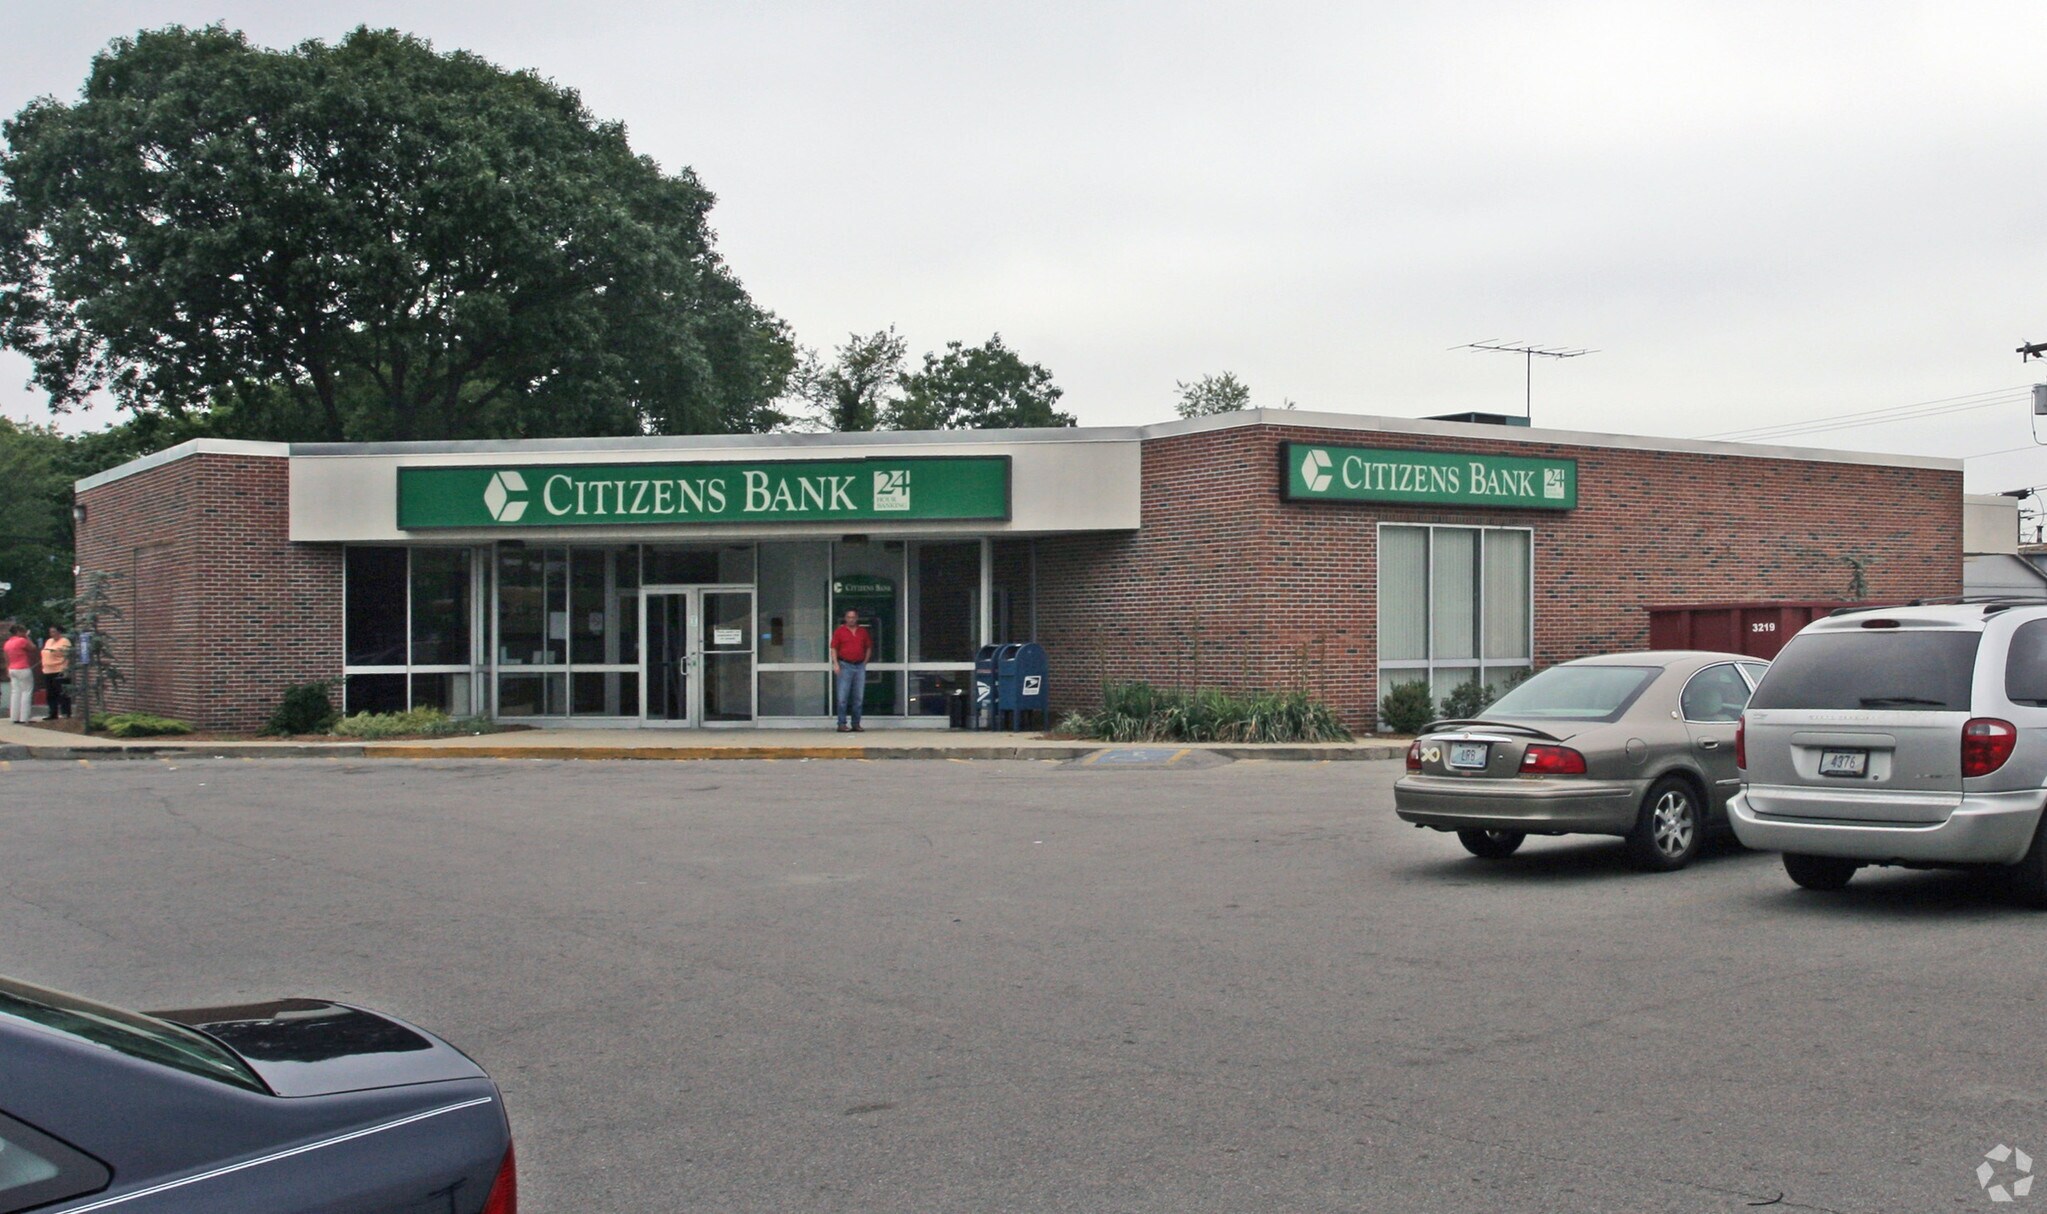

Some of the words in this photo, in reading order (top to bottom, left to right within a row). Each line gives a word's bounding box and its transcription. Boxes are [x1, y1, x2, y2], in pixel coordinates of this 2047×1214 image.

[876, 470, 910, 496] 24
[1342, 455, 1460, 494] CITIZENS
[1469, 462, 1536, 497] BANK
[1546, 468, 1565, 488] 24
[543, 474, 726, 516] CITIZENS
[742, 471, 858, 512] BANK
[845, 584, 874, 592] CITIZENS
[875, 584, 891, 592] BANK
[1752, 623, 1776, 632] 3219
[1830, 754, 1856, 769] 4376
